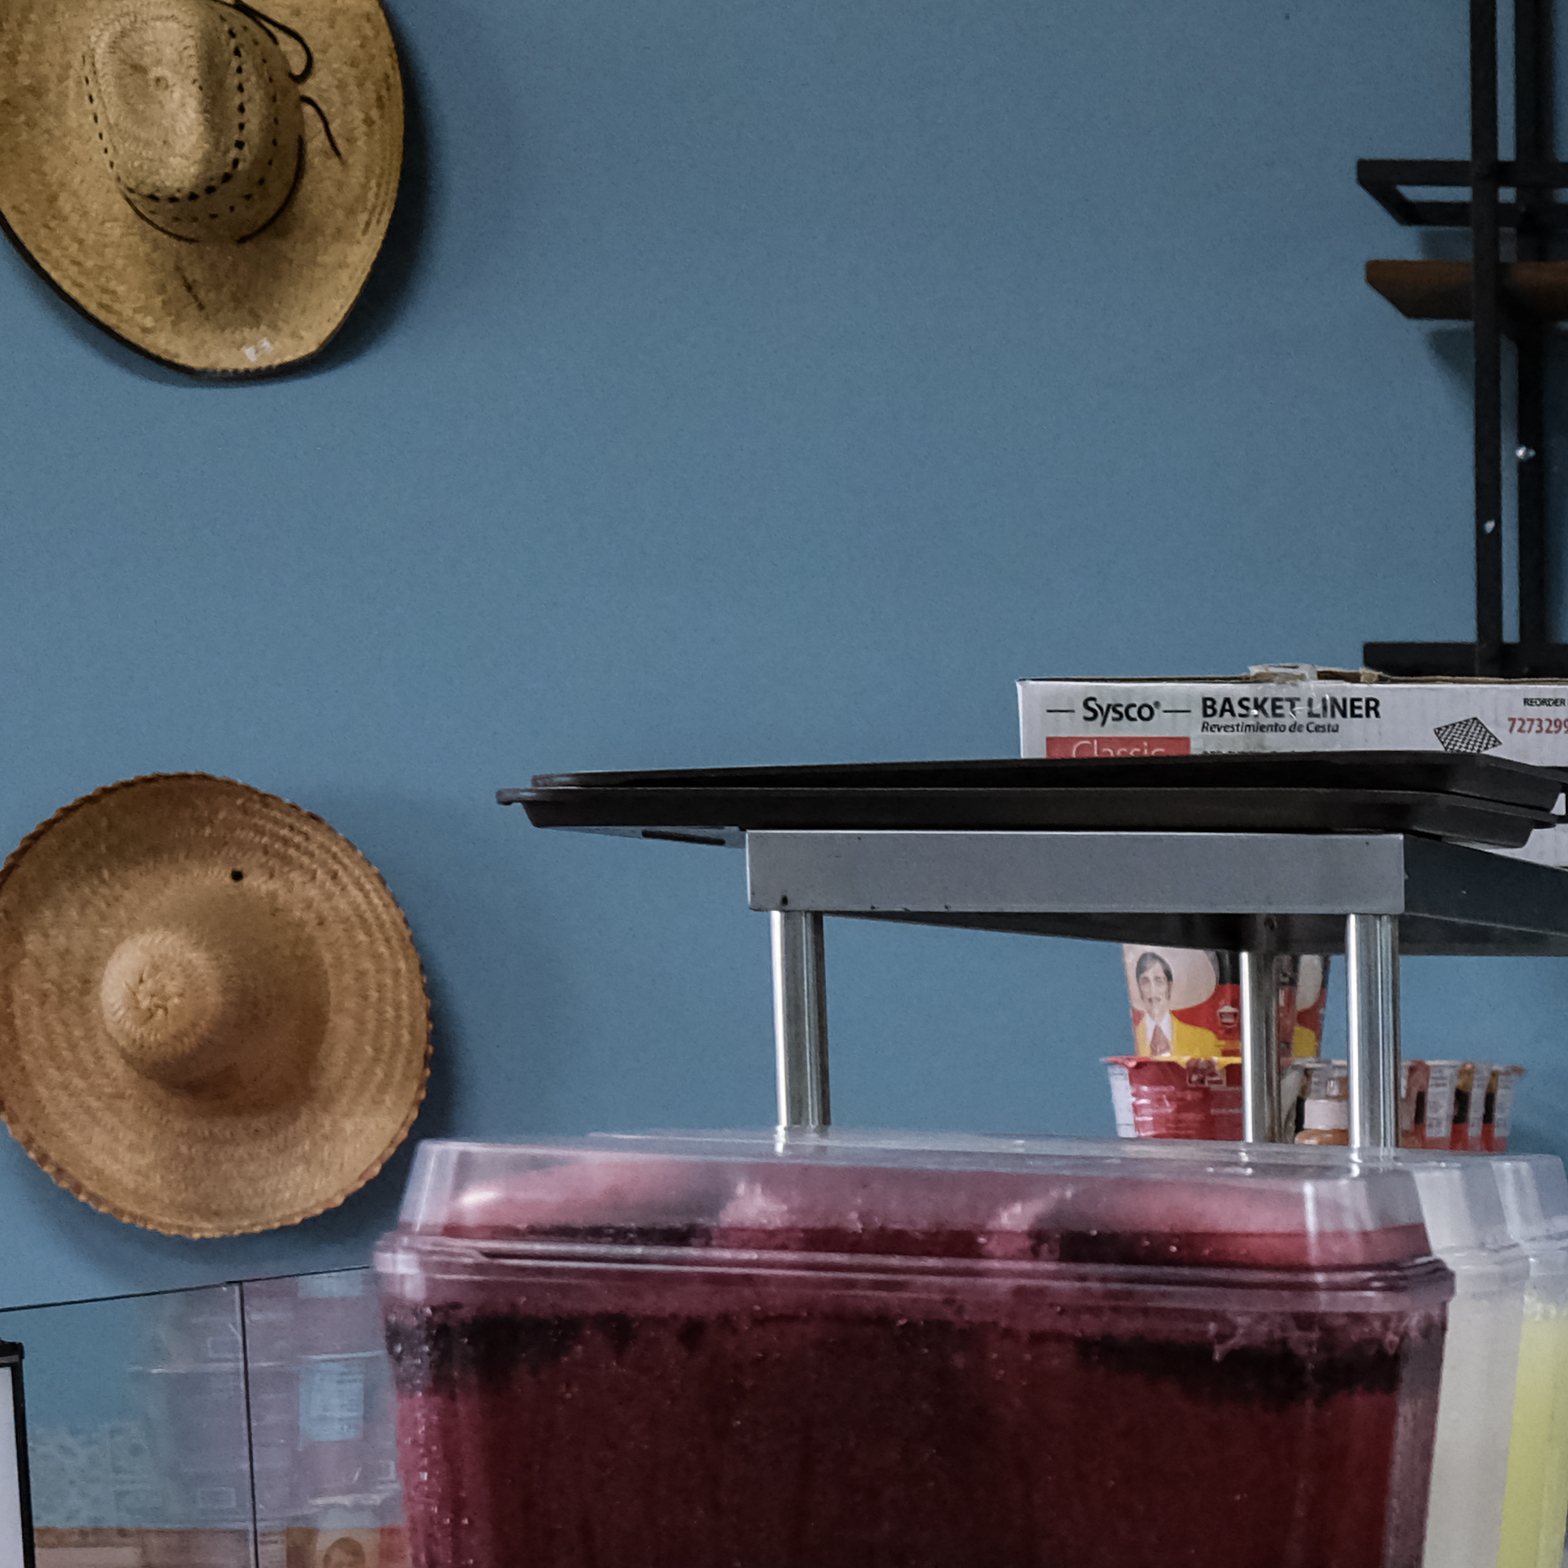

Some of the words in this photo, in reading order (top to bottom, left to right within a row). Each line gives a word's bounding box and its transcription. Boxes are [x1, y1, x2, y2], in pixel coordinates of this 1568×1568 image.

[1201, 696, 1302, 719] BASKET
[1306, 696, 1381, 719] LINER
[1523, 697, 1566, 707] REORDER
[1201, 721, 1286, 733] Revestimiento
[1288, 721, 1304, 733] de
[1306, 721, 1340, 733] Cesta
